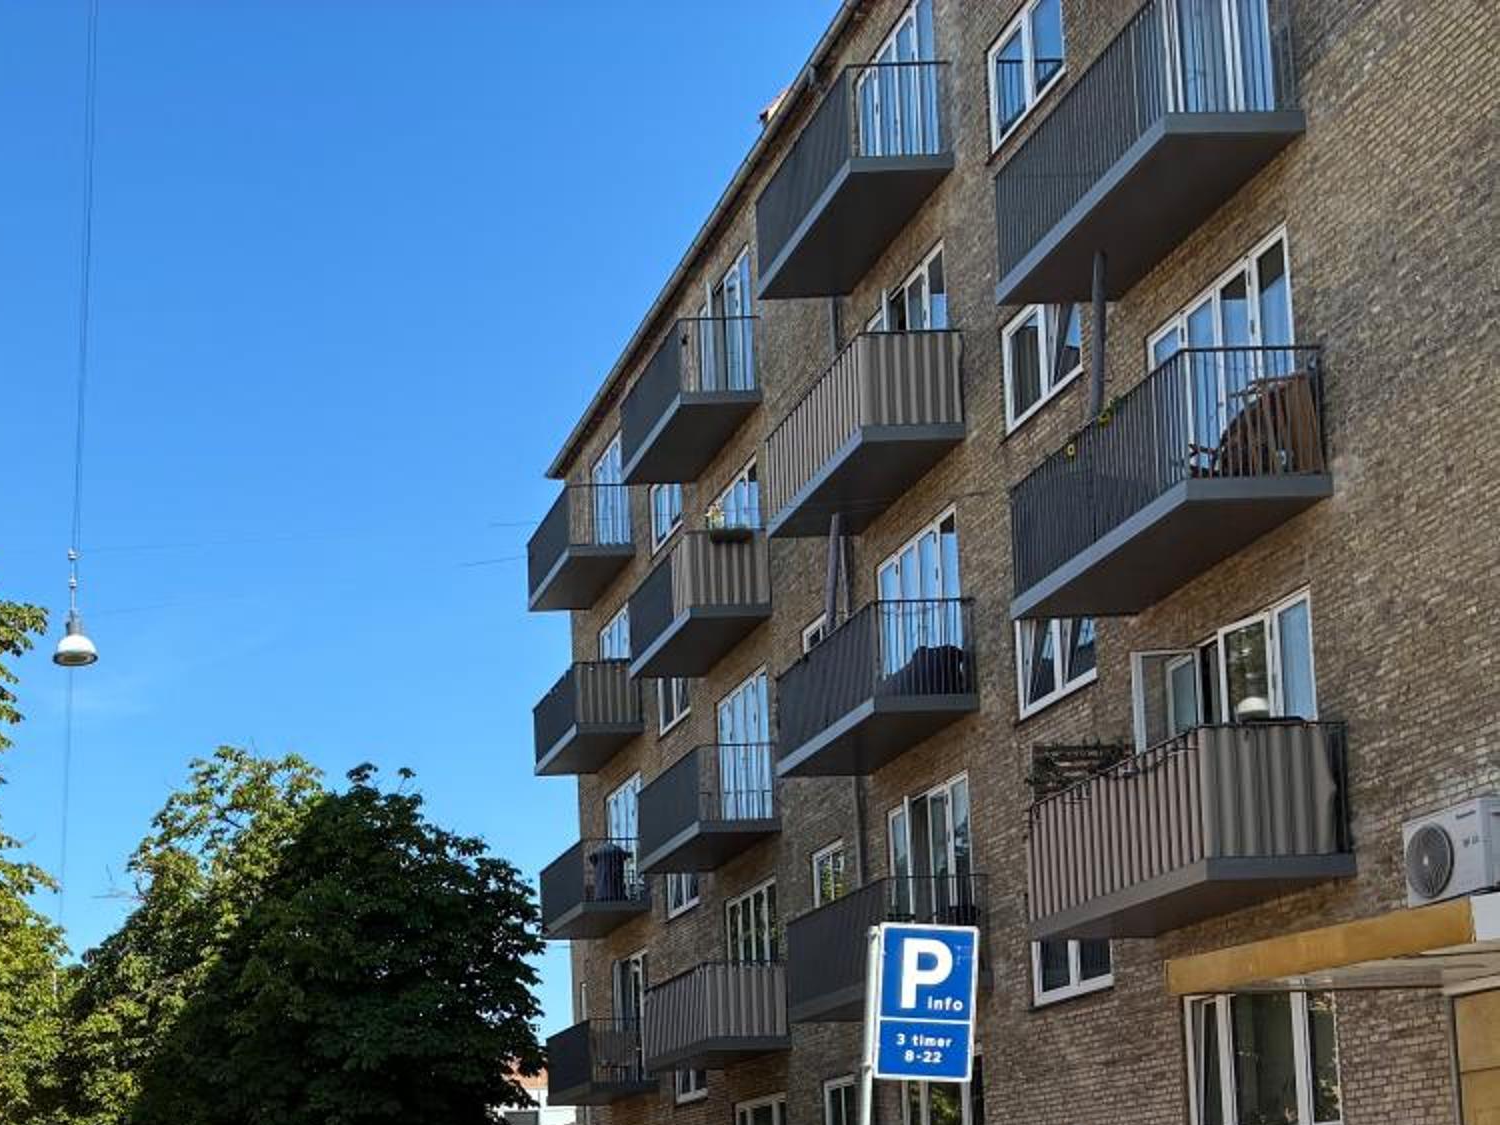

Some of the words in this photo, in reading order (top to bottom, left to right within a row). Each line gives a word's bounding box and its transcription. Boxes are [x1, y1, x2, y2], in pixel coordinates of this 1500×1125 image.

[901, 937, 953, 1009] P
[896, 1033, 906, 1046] 3
[912, 1034, 952, 1047] timer
[904, 1050, 942, 1063] 8-22
